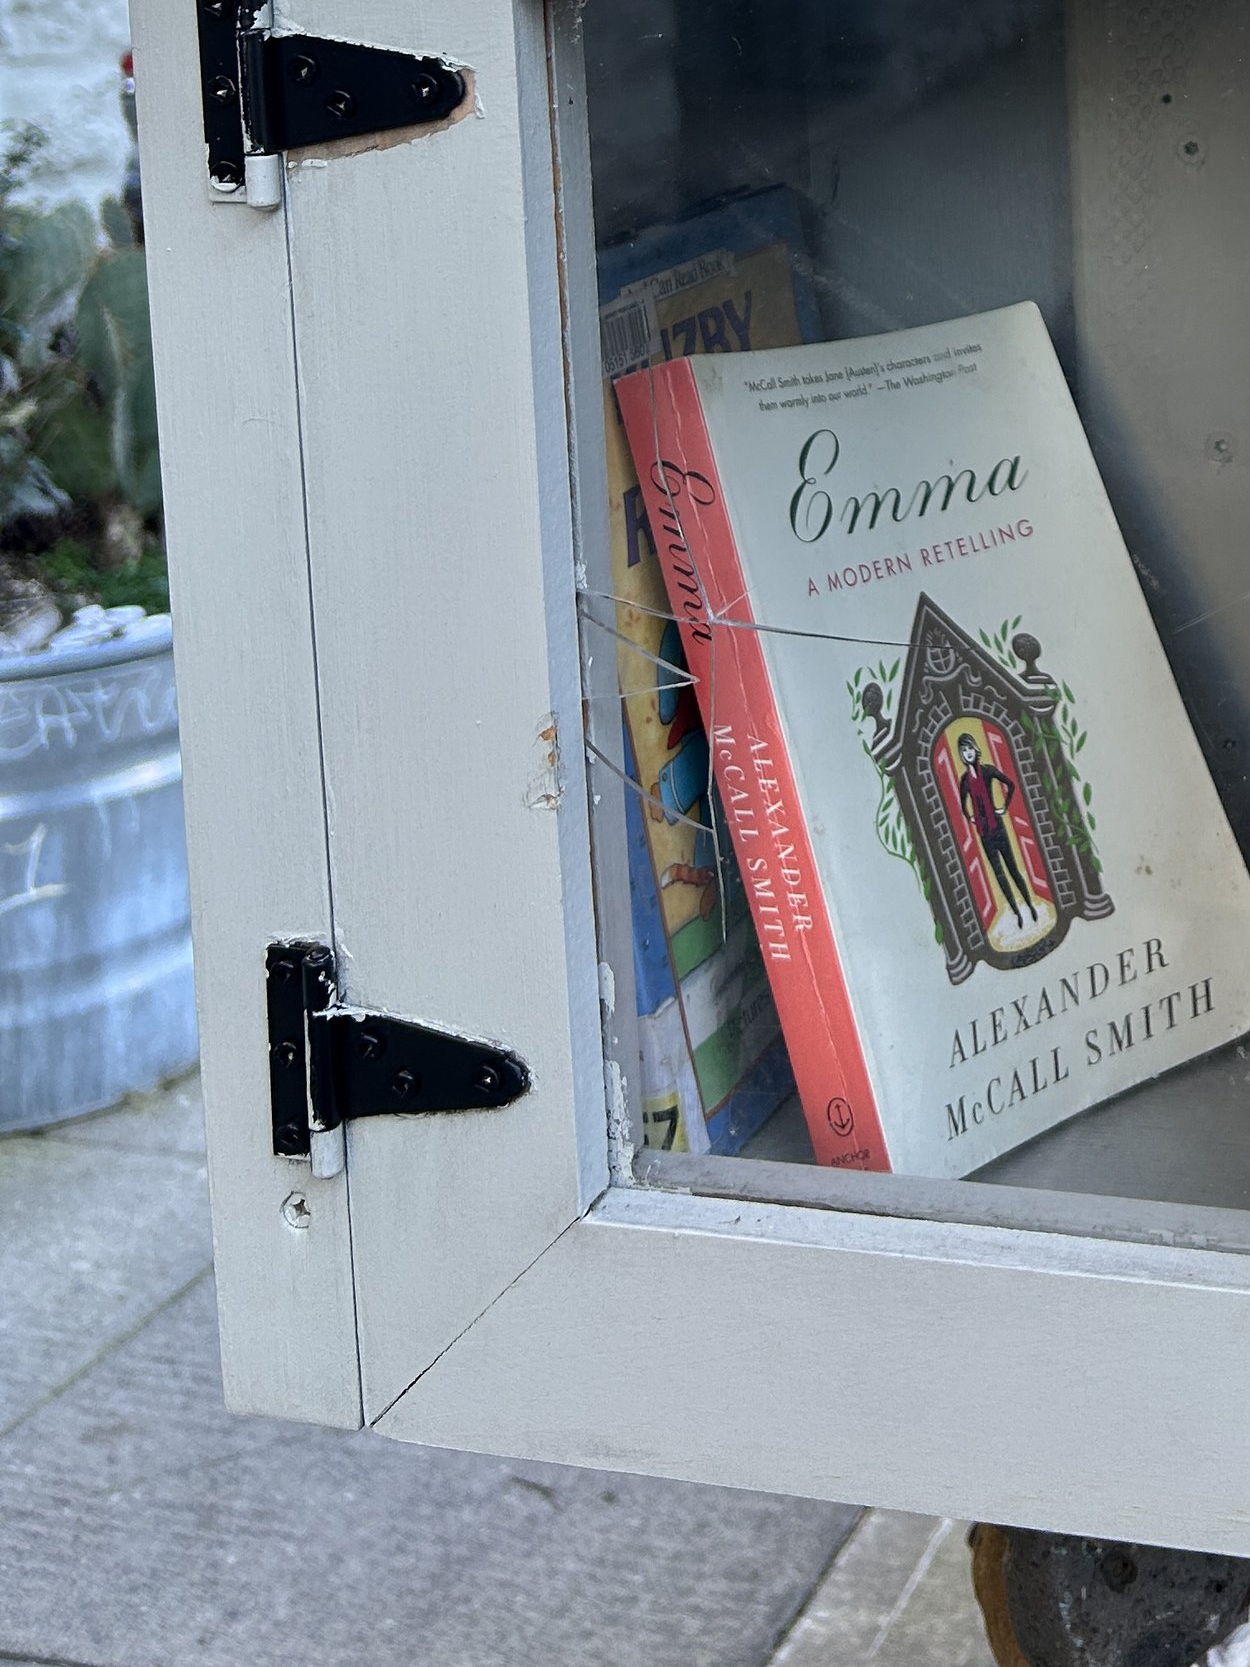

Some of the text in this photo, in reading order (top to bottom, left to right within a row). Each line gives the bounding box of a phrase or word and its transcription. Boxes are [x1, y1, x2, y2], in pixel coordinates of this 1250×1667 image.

[758, 398, 779, 412] them
[780, 393, 809, 409] warmly
[811, 391, 827, 405] into
[828, 390, 842, 401] our
[902, 368, 957, 388] Washington
[957, 361, 978, 375] Post
[778, 372, 801, 389] Smith
[802, 370, 824, 385] takes
[825, 368, 844, 383] Jane
[886, 354, 932, 371] characters
[932, 349, 952, 363] and
[953, 342, 983, 358] invites
[790, 429, 1029, 543] Emma
[651, 460, 716, 647] Emma
[807, 519, 1034, 597] A MODERN RETELLING
[713, 724, 760, 843] McCALL
[747, 857, 792, 961] SMITH
[747, 733, 814, 933] ALEXANDER
[944, 976, 1216, 1142] McCALL SMITH
[949, 937, 1169, 1069] ALEXANDER
